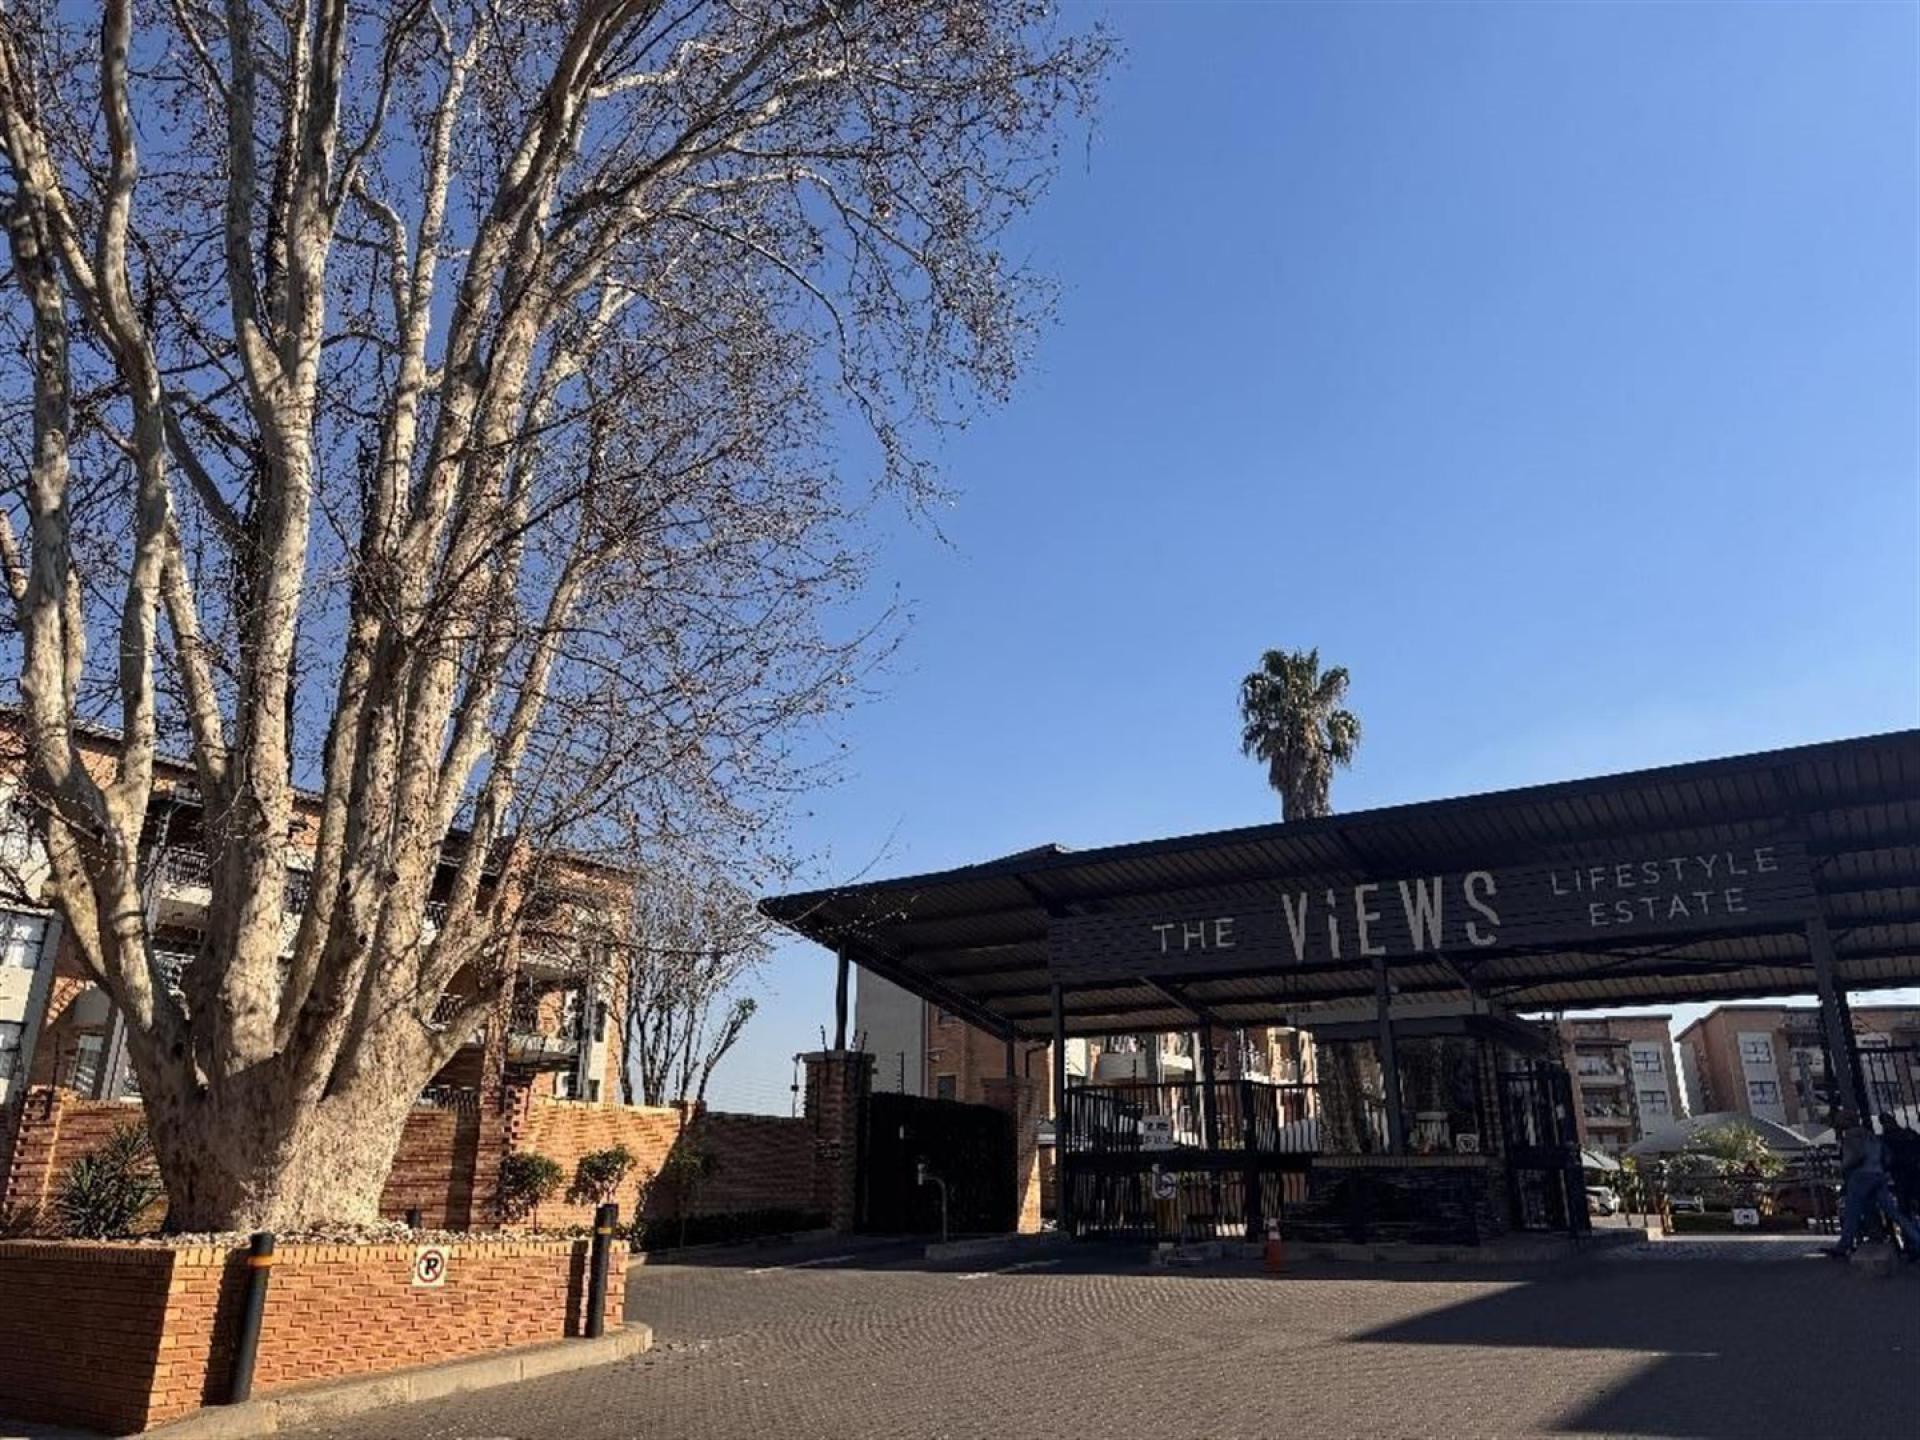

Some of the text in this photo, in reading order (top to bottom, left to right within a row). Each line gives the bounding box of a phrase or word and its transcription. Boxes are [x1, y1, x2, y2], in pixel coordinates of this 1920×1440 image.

[1550, 847, 1778, 895] LIFESTYLE
[1589, 888, 1748, 927] ESTATE
[1152, 917, 1236, 953] THE
